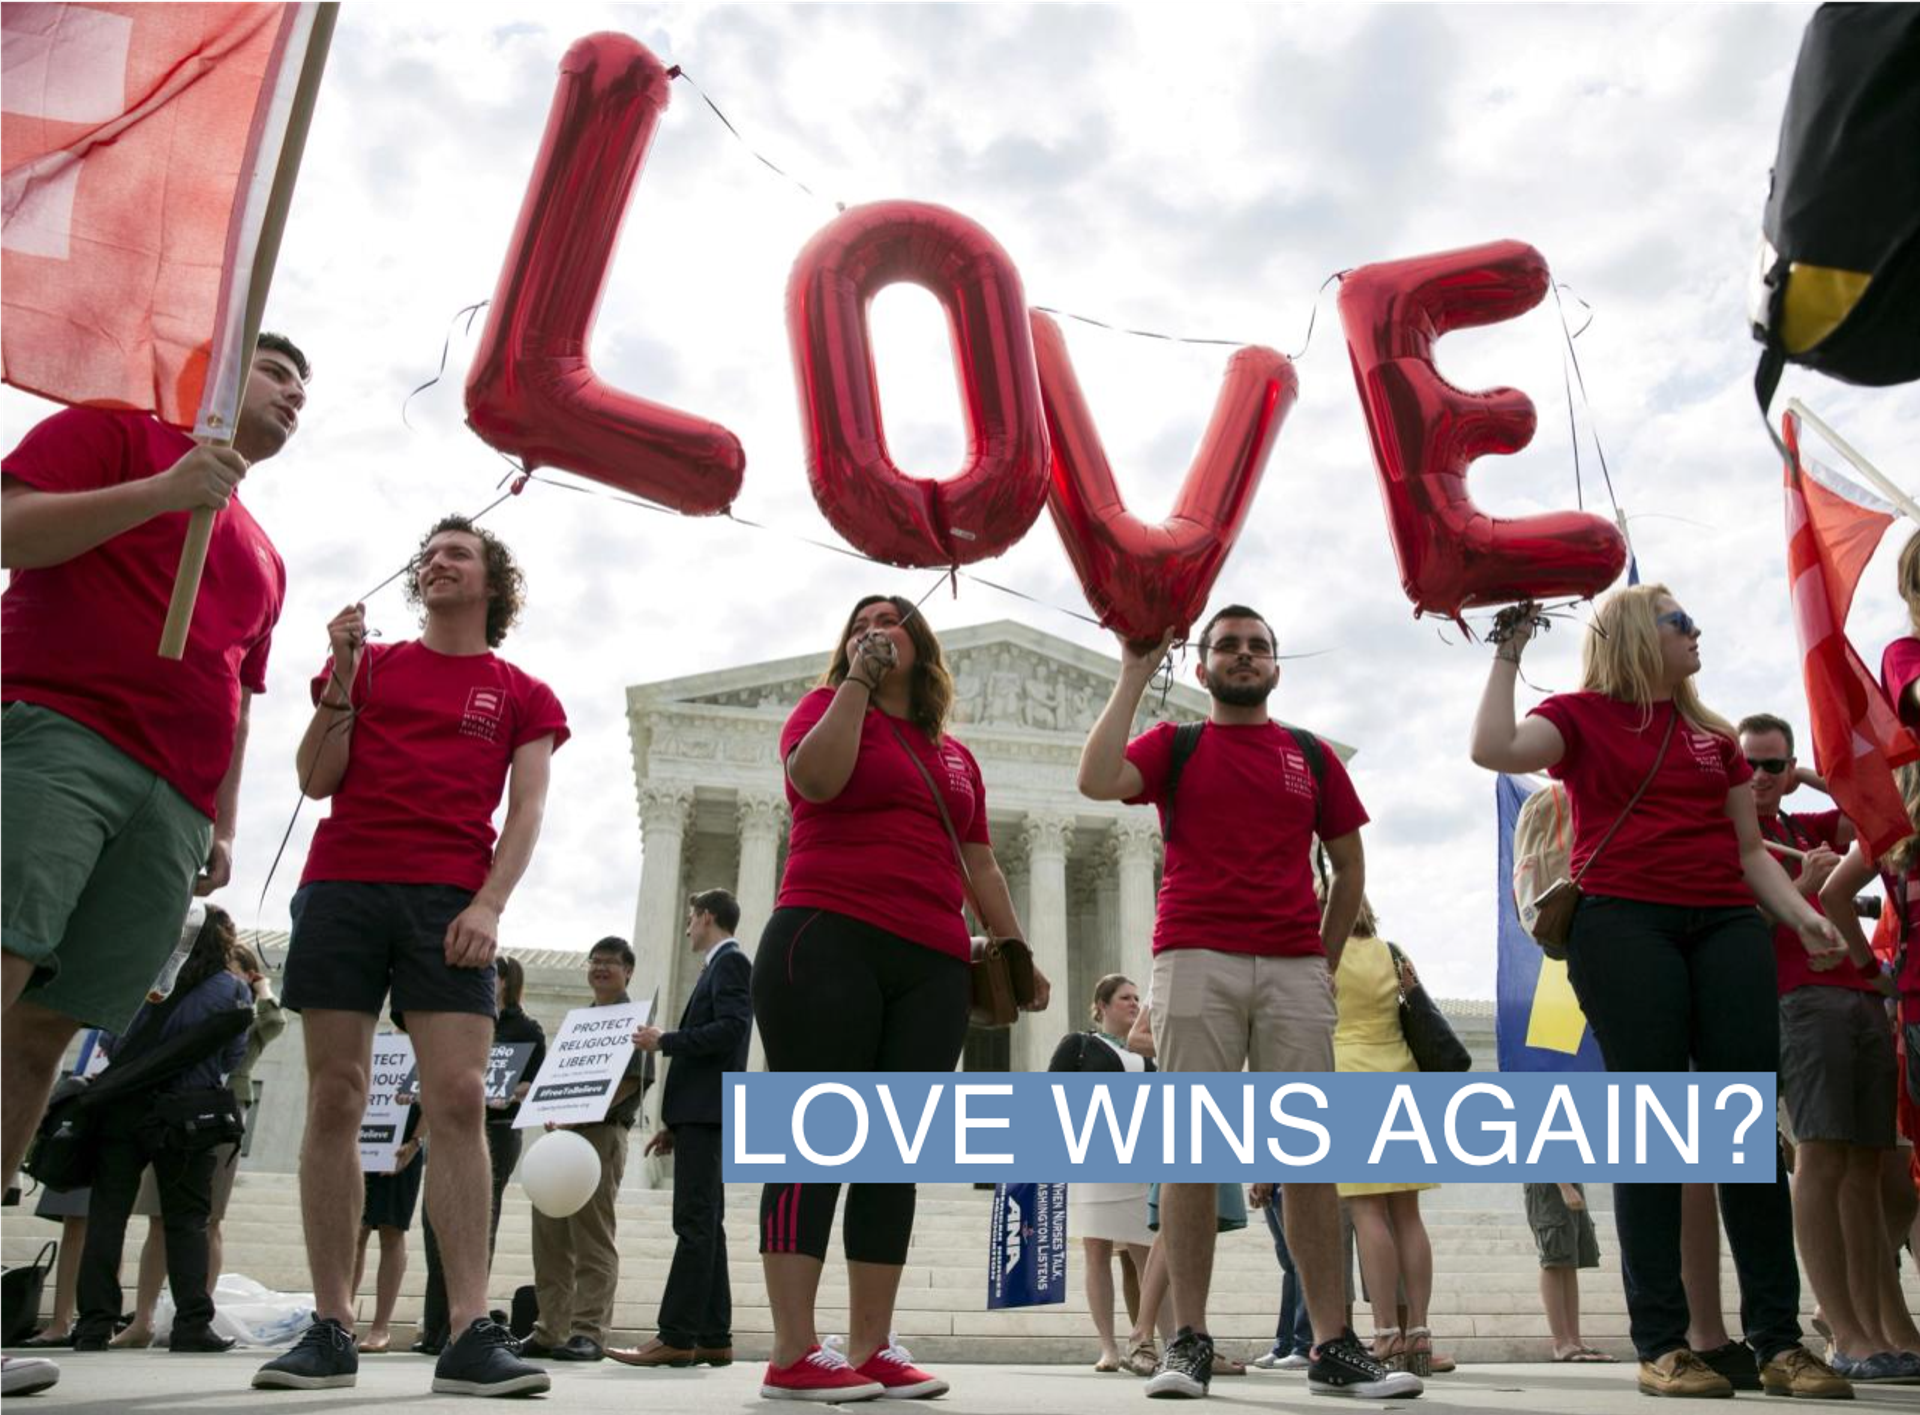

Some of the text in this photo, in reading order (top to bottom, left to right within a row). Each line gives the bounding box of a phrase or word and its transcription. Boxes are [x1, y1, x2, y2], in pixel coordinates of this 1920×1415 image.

[464, 31, 1627, 645] LOVE
[572, 1017, 634, 1033] PROTECT
[490, 1046, 514, 1057] IÑO
[558, 1034, 629, 1052] RELIGIOUS
[374, 1053, 407, 1065] TECT
[558, 1053, 613, 1068] LIBERTY
[1037, 1183, 1049, 1241] ASHINGTON
[1006, 1195, 1021, 1274] ANA
